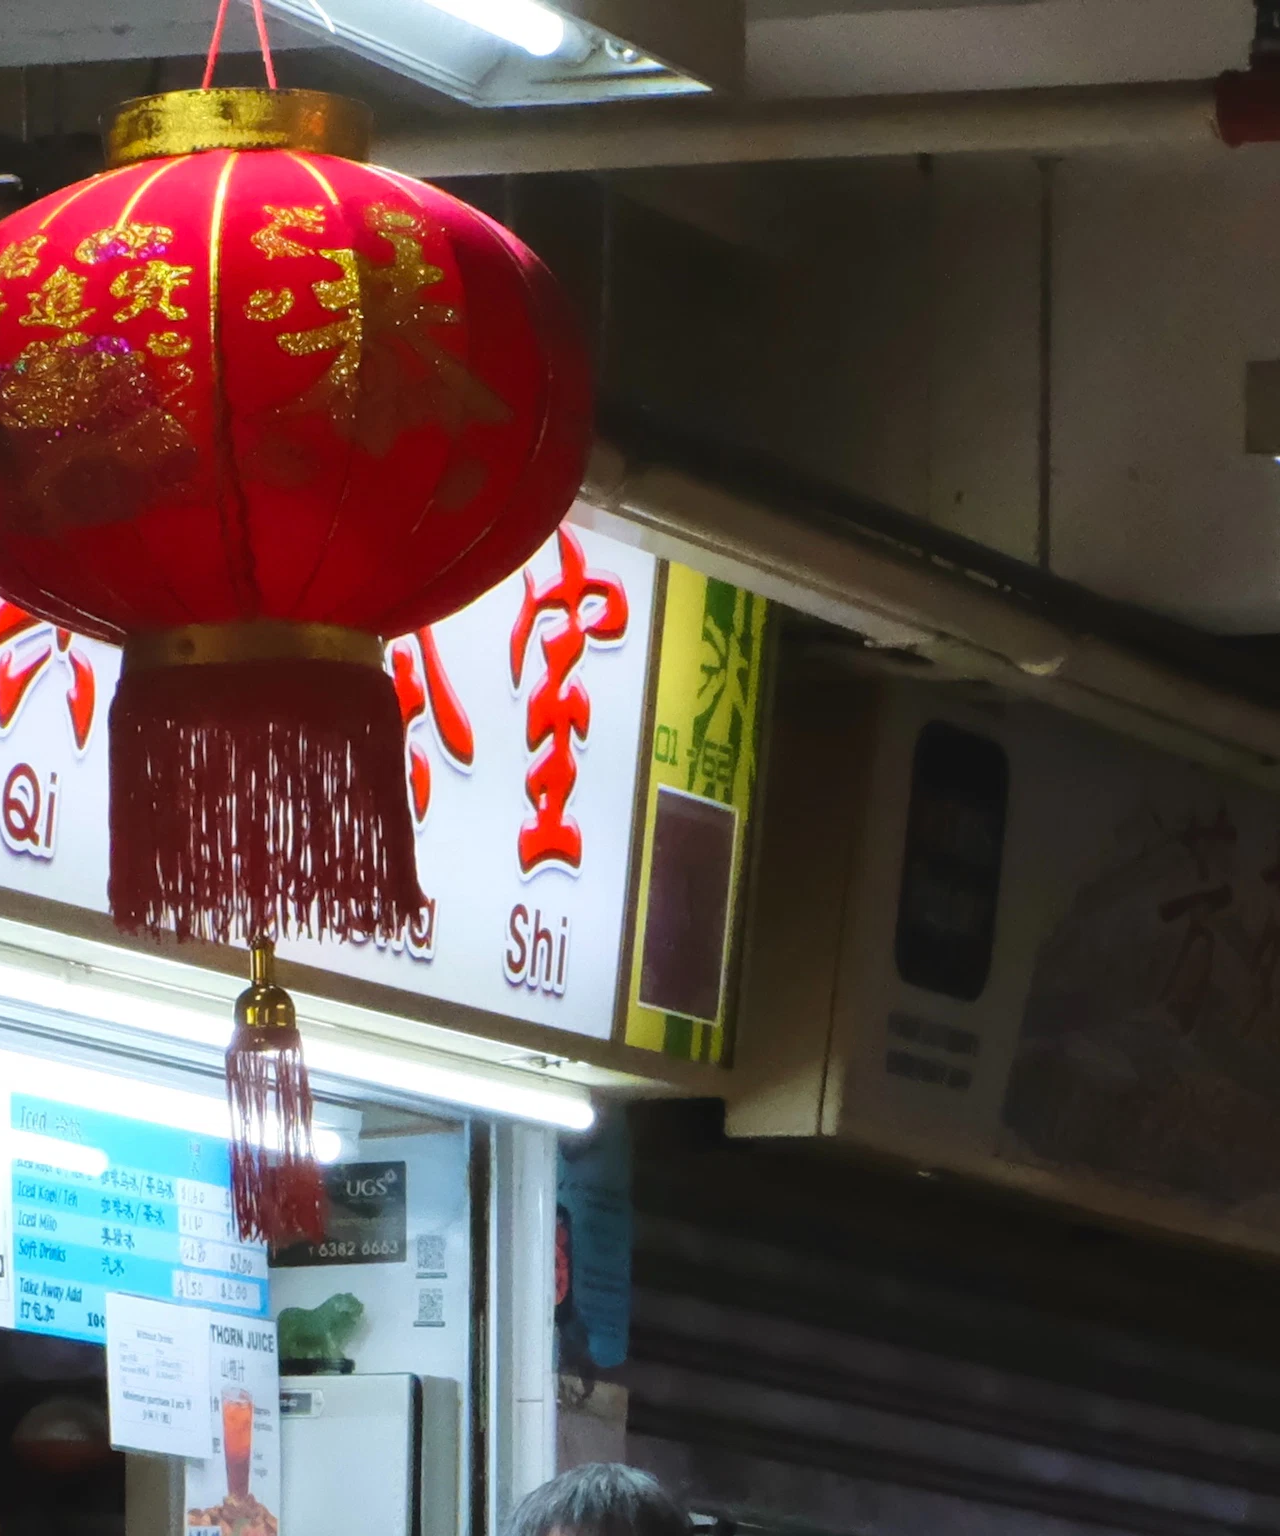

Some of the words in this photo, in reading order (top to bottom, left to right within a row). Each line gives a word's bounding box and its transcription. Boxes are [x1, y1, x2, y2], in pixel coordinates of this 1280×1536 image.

[2, 762, 58, 853] Qi
[505, 903, 569, 993] Shi
[346, 1176, 390, 1197] UGS
[320, 1241, 356, 1258] 6382
[361, 1240, 400, 1256] 6663
[245, 1331, 275, 1354] JUICE
